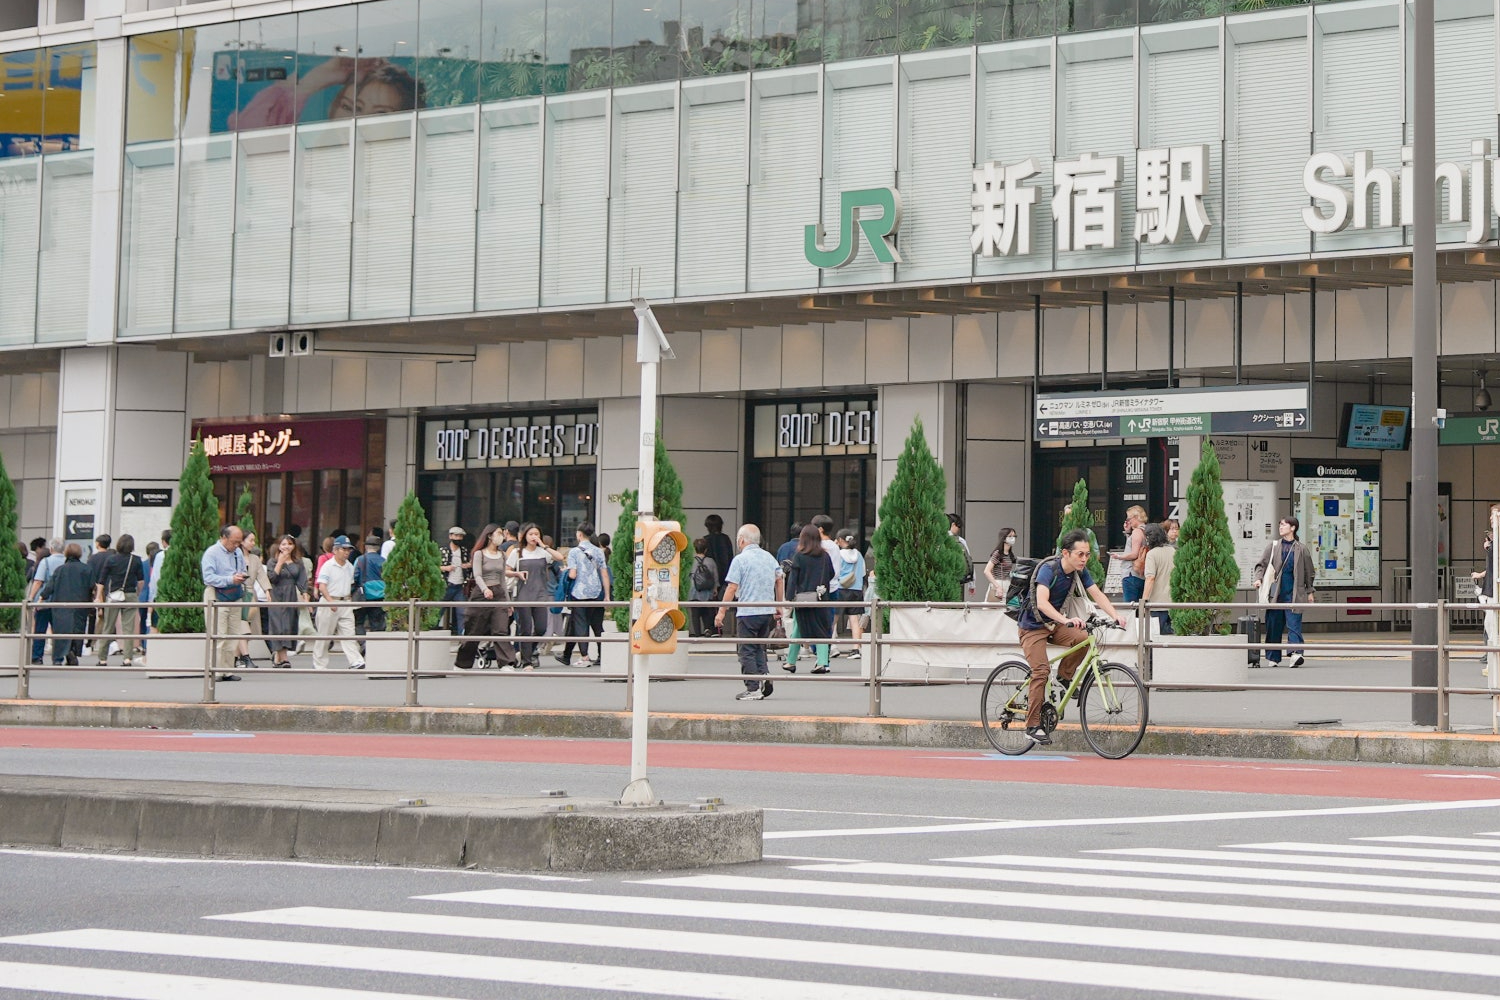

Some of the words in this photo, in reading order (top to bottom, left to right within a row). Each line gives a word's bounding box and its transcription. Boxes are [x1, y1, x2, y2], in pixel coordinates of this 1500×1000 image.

[804, 187, 903, 269] JR
[970, 144, 1212, 258] 新宿駅
[1138, 418, 1152, 429] JR
[1252, 413, 1275, 423] タクシー
[1477, 418, 1499, 436] JR
[476, 424, 565, 461] DEGREES
[1325, 466, 1357, 477] Information
